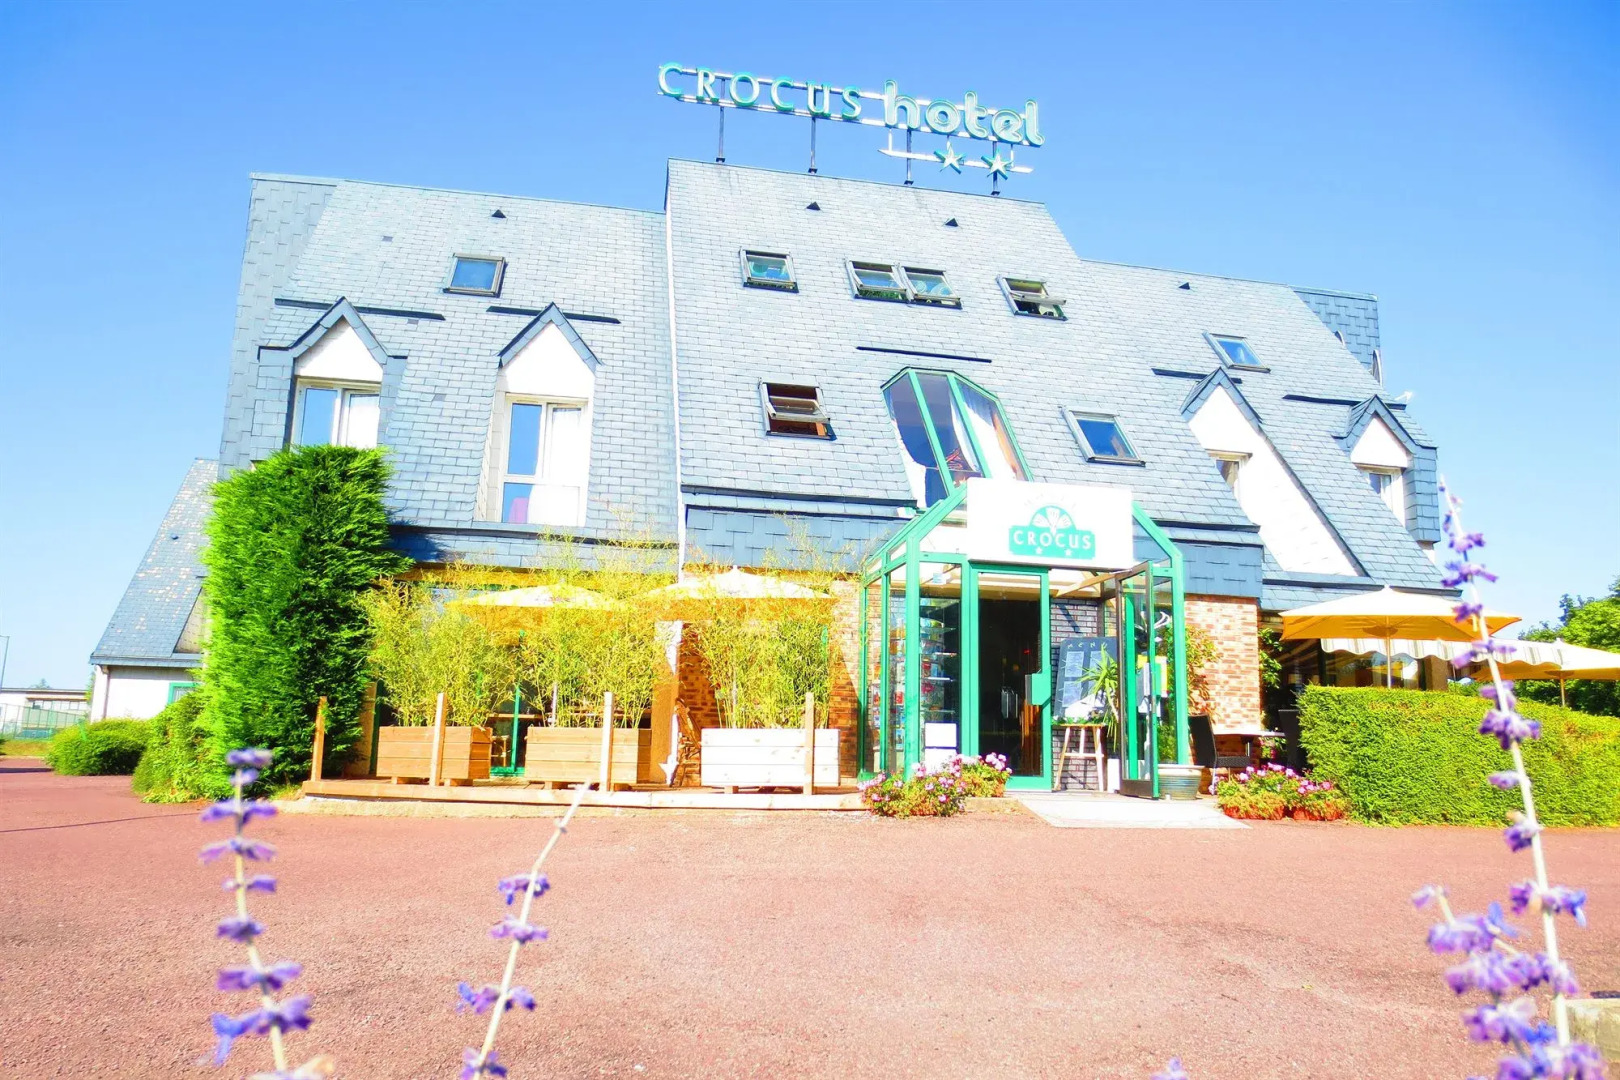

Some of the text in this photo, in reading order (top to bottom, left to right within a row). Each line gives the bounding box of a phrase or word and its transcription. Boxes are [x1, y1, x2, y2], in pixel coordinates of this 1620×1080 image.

[658, 62, 1045, 146] CROCUS hotel
[1013, 530, 1092, 550] CROCUS
